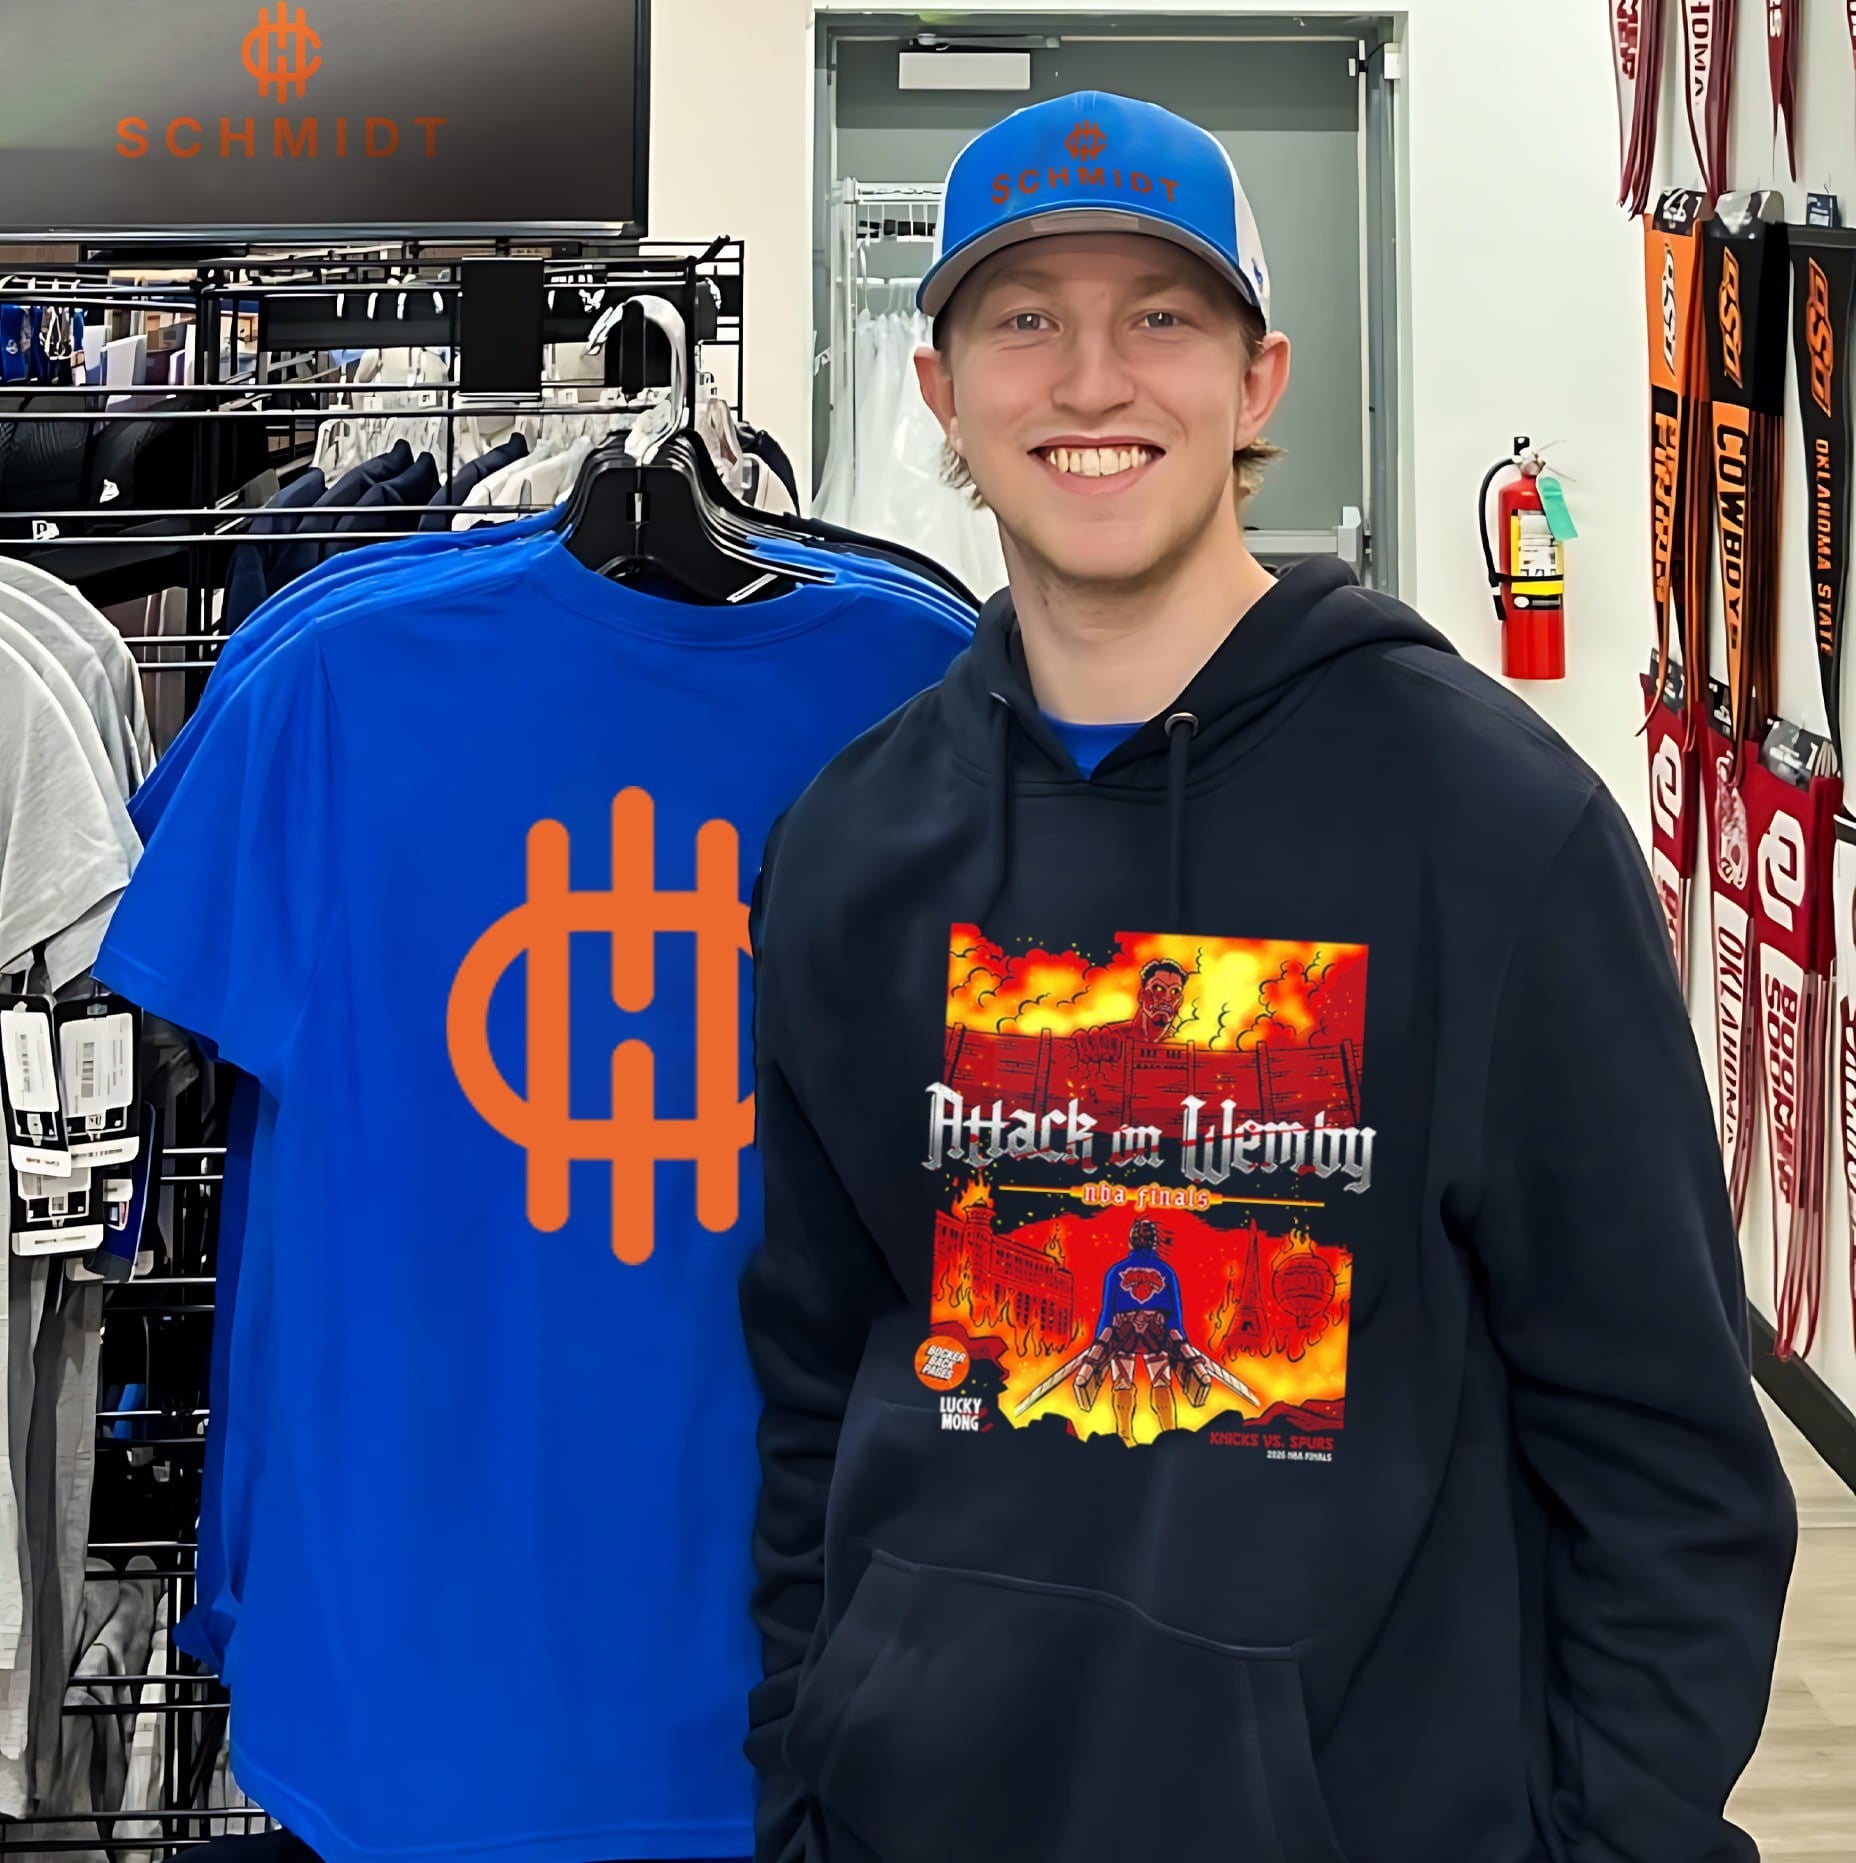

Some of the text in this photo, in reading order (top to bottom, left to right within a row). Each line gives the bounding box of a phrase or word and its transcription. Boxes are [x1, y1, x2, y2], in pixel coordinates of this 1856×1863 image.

[115, 116, 447, 159] SCHMIDT
[991, 166, 1179, 205] SCHMIDT
[1815, 438, 1833, 657] OKLAHOMA STATE
[1718, 926, 1744, 1143] OKLAHOMA
[919, 1081, 1098, 1174] Attack
[1180, 1094, 1377, 1195] Wemby
[1084, 1184, 1208, 1208] nba finals
[921, 1363, 954, 1380] PAGES
[928, 1355, 955, 1370] BACK
[940, 1396, 982, 1415] LUCKY
[941, 1413, 979, 1432] MONG
[1209, 1431, 1334, 1450] KNICKS VS. SPURS
